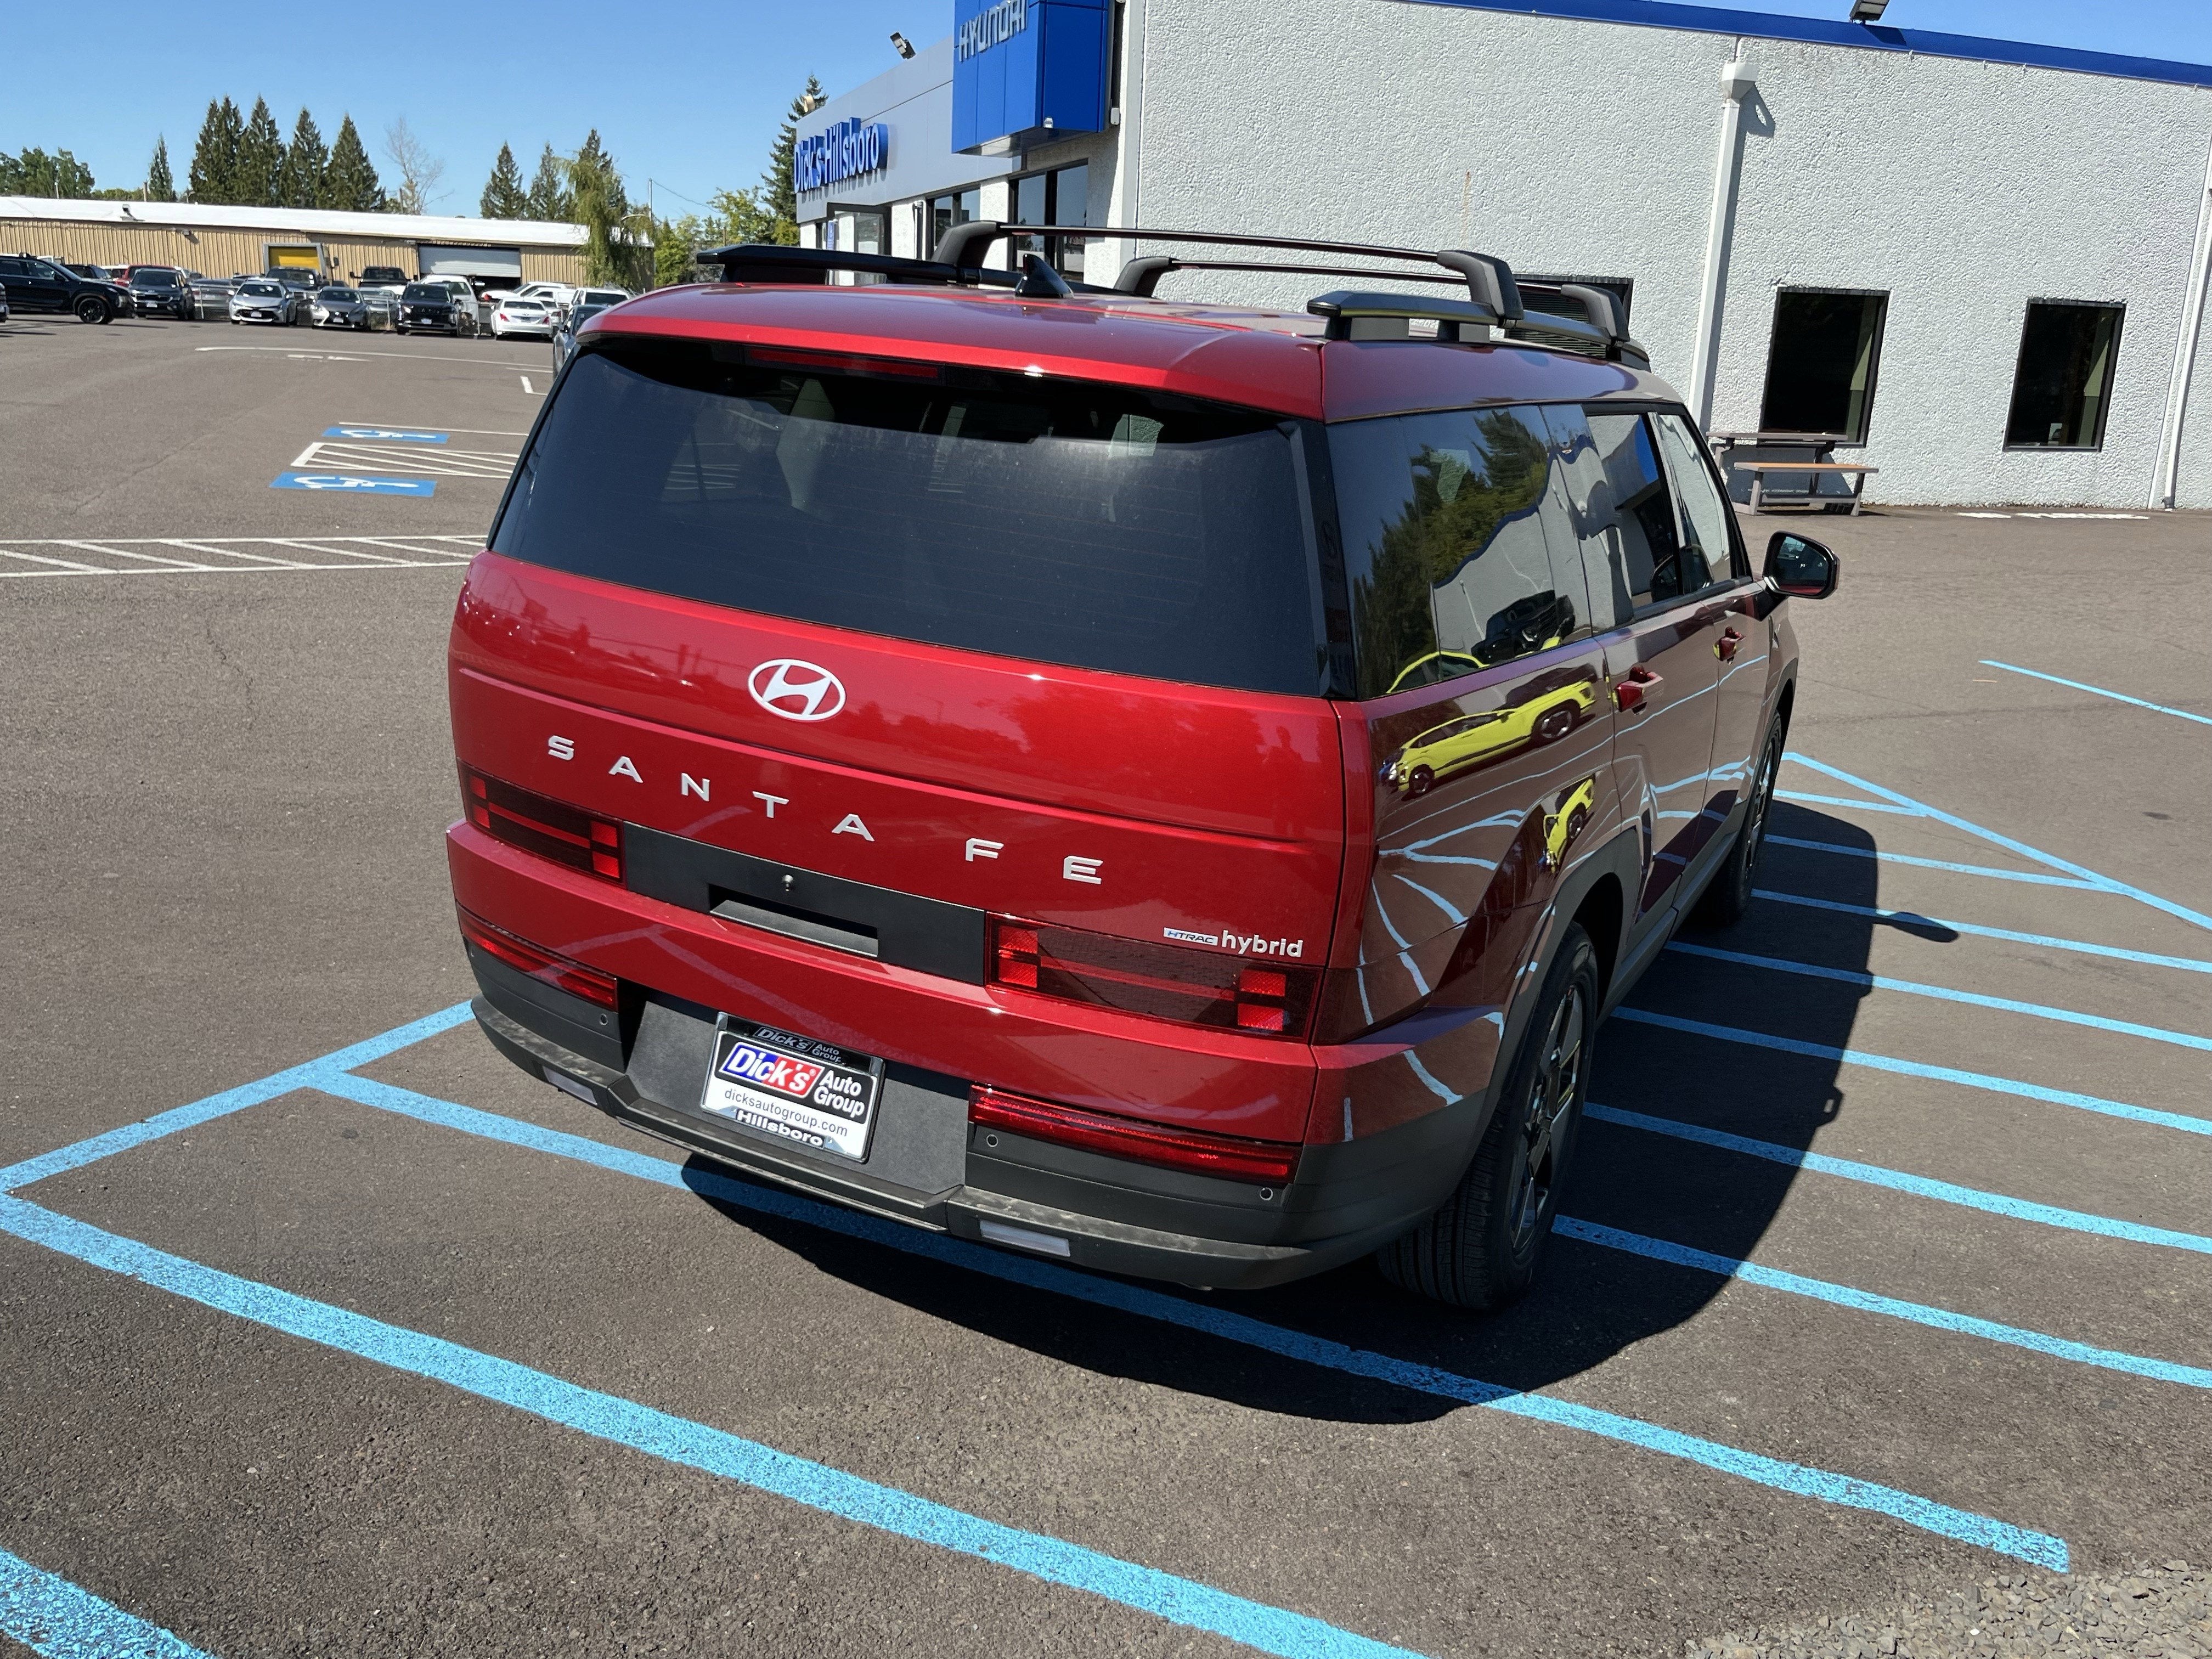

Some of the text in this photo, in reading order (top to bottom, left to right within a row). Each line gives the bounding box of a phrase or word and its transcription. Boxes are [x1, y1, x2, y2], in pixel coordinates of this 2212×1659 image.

[958, 0, 1026, 62] HYUNDAI
[794, 117, 882, 194] Dick's Hillsboro
[547, 734, 1103, 885] SANTA FE
[1167, 929, 1304, 958] HTRAC hybrid
[756, 1028, 809, 1050] Dick's
[815, 1043, 840, 1056] Auto
[811, 1049, 843, 1063] Group
[819, 1070, 862, 1096] Auto
[724, 1088, 848, 1137] dicksautogroup.com
[814, 1086, 865, 1118] Group
[736, 1109, 823, 1146] Hillsboro
